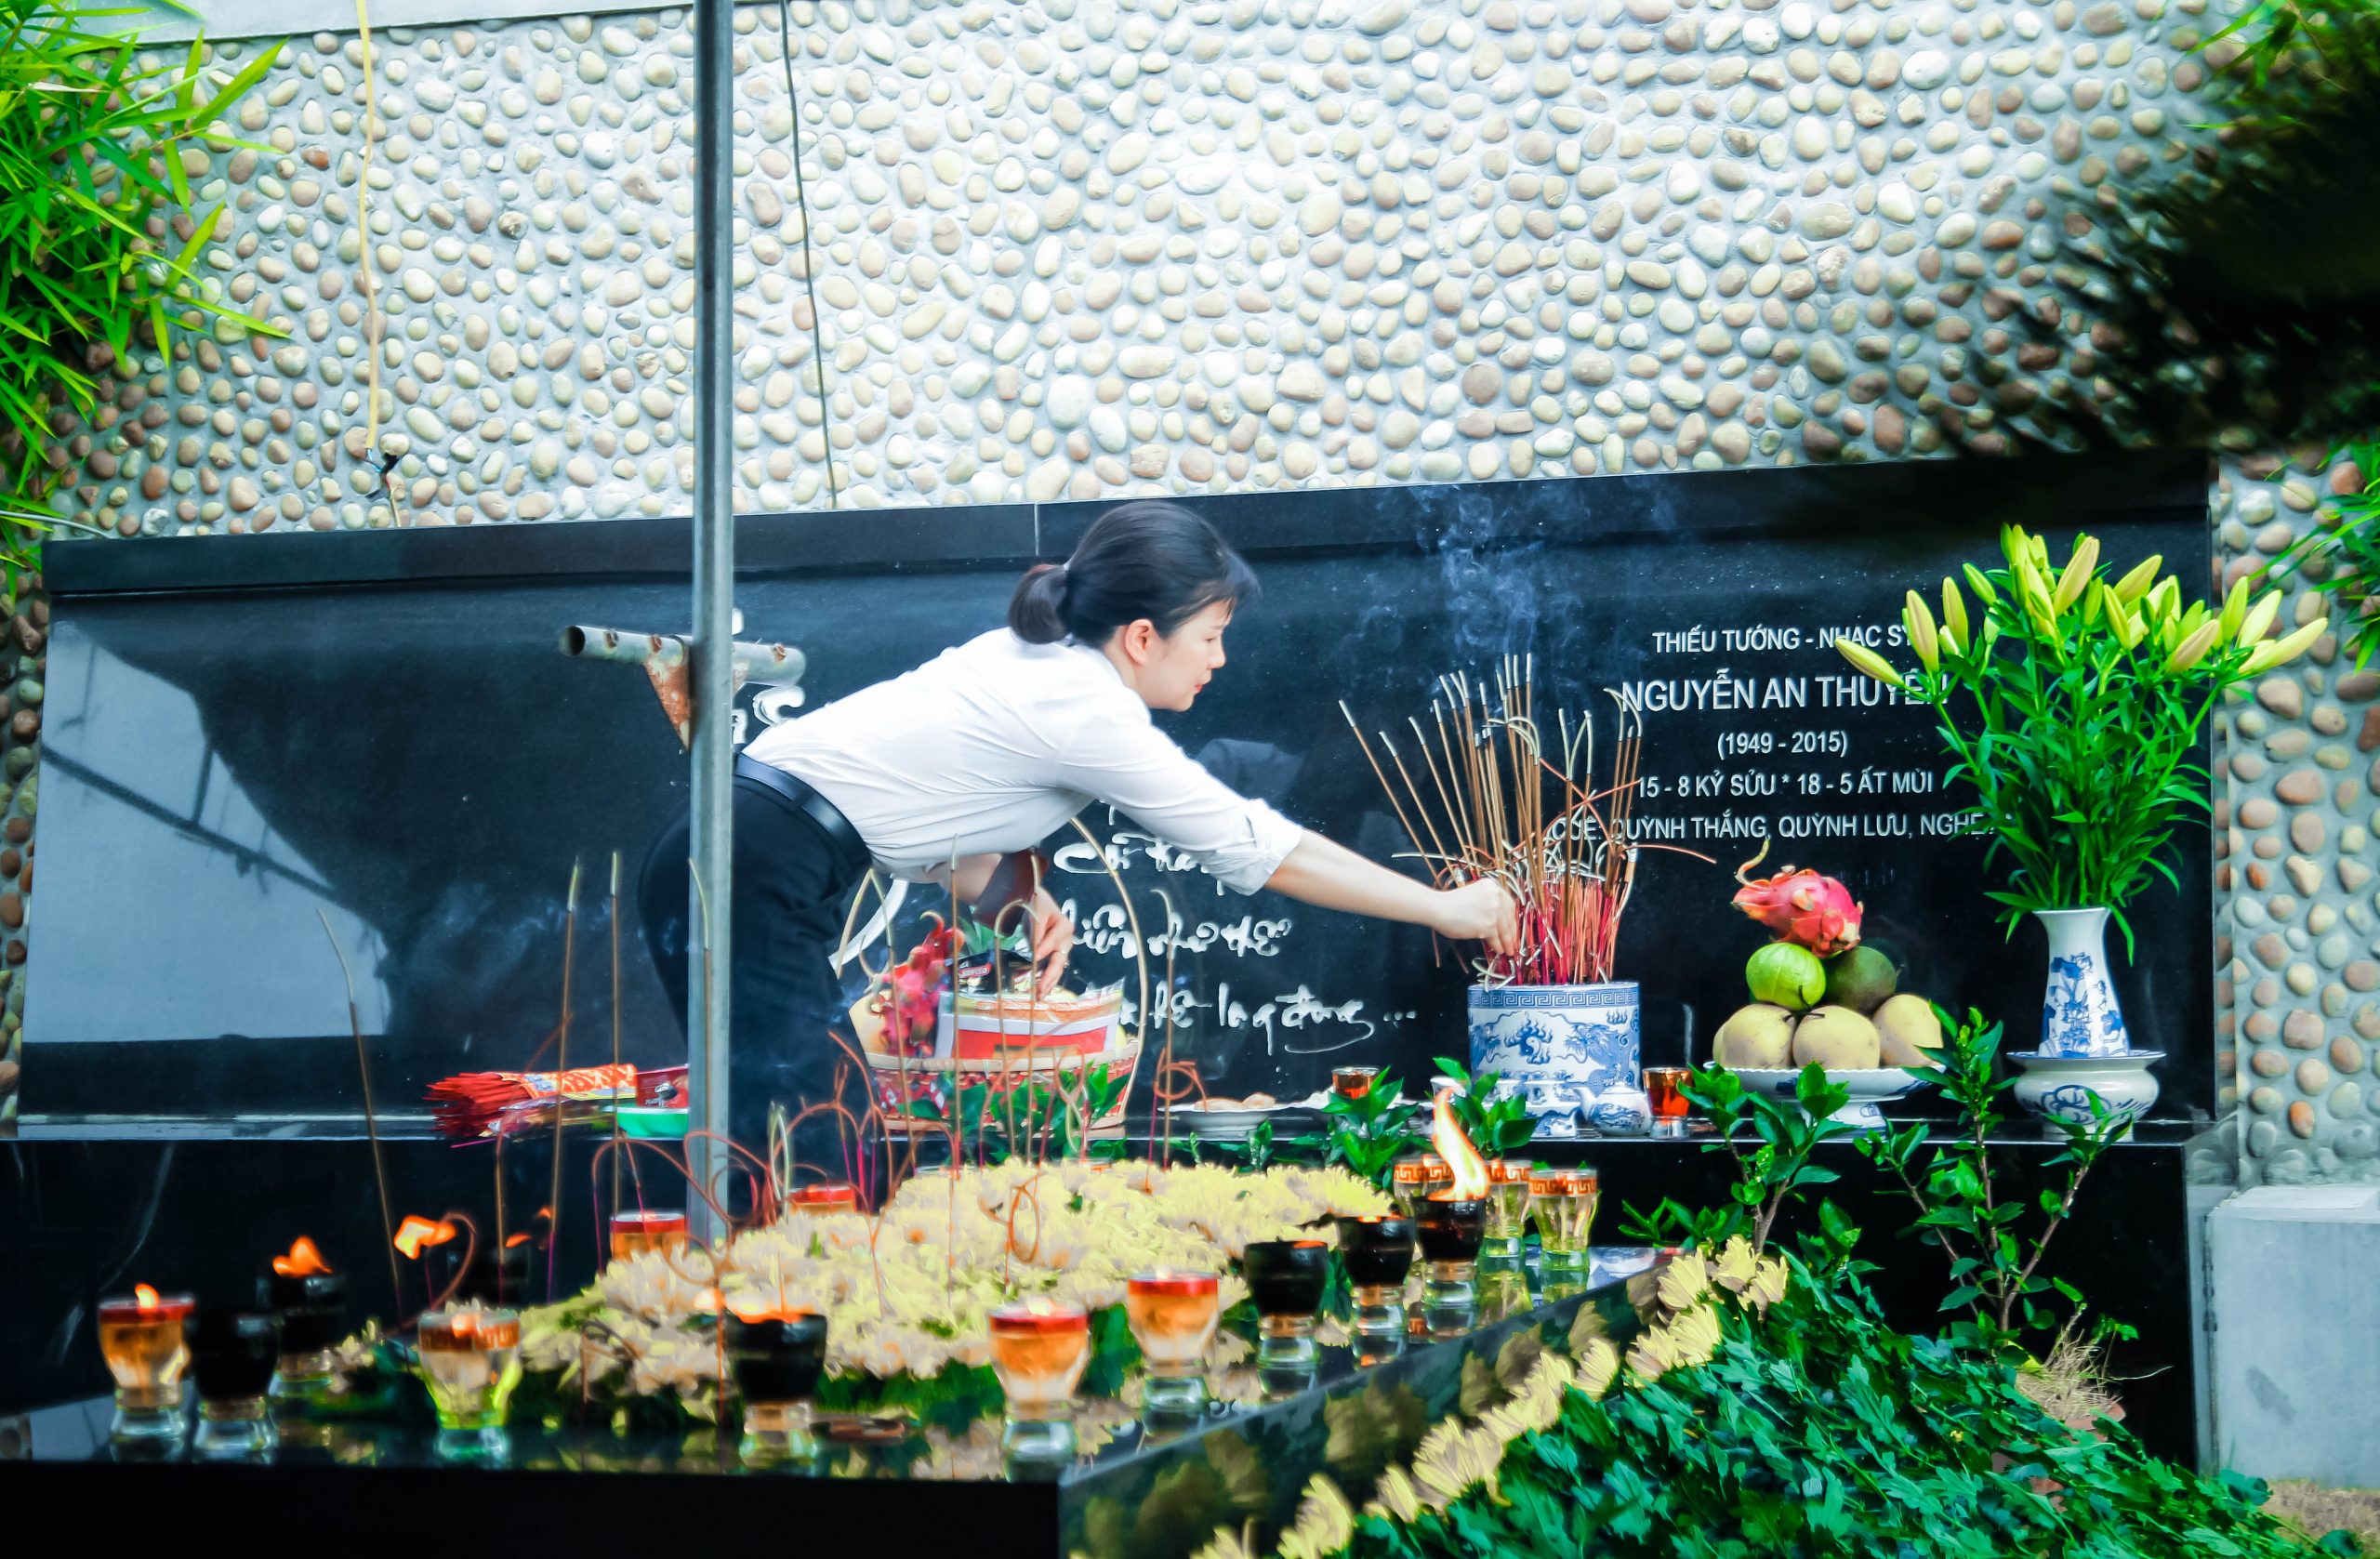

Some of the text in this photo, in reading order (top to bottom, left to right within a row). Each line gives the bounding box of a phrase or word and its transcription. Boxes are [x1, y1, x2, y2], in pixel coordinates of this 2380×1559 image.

[1651, 624, 1717, 654] THIẾU
[1721, 623, 1801, 652] TƯỚNG
[1621, 667, 1755, 712] NGUYỄN
[1761, 677, 1807, 709] AN
[1717, 732, 1774, 760] (1949
[1792, 731, 1848, 758] 2015)
[1639, 775, 1660, 798] 15
[1677, 775, 1690, 797] 8
[1695, 769, 1725, 797] KỶ
[1730, 769, 1776, 796] SỬU
[1797, 773, 1822, 795] 18
[1840, 773, 1853, 795] 5
[1858, 765, 1887, 794] ẤT
[1892, 768, 1934, 793] MÙI
[1778, 813, 1857, 839] QUỲNH
[1863, 813, 1912, 839] LƯU,
